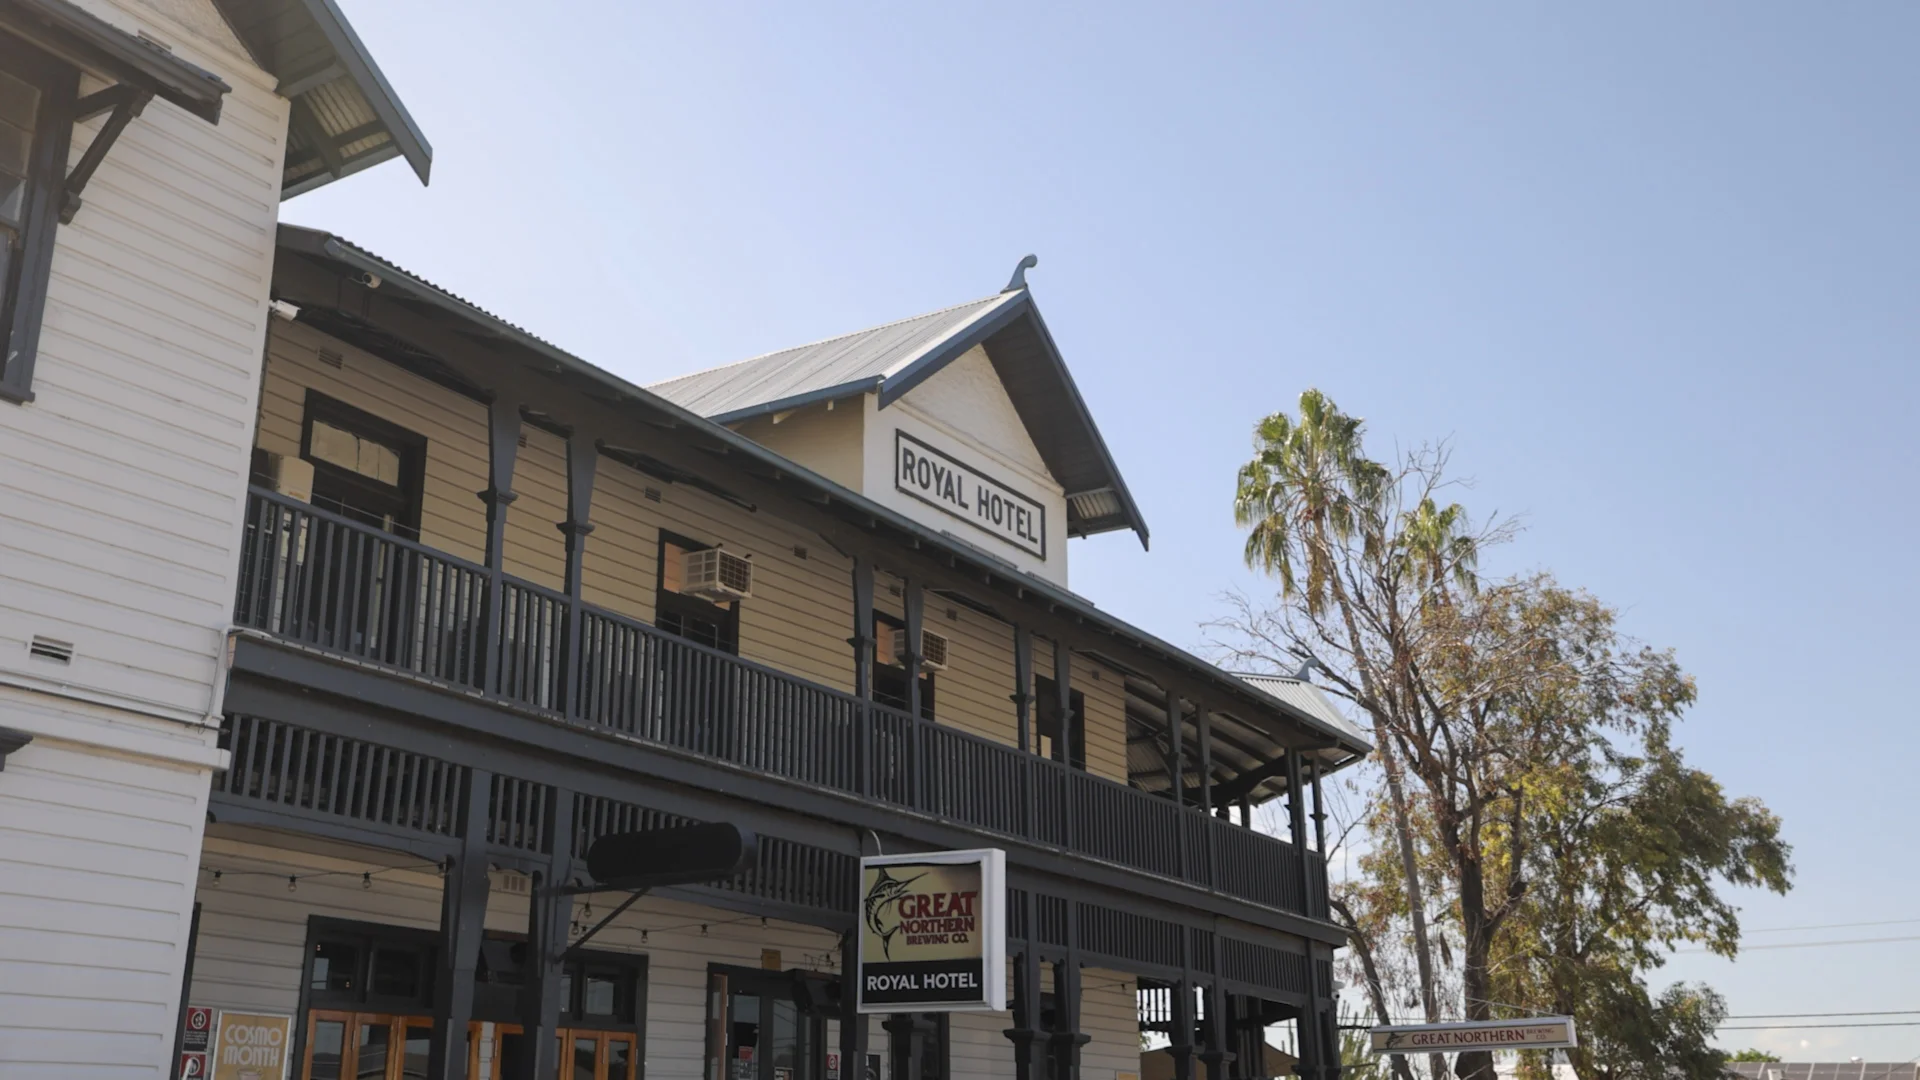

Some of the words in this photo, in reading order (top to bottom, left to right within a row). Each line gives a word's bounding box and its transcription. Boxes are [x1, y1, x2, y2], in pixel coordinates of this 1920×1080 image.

[902, 446, 969, 510] ROYAL
[977, 484, 1038, 544] HOTEL
[898, 891, 978, 919] GREAT
[900, 917, 975, 934] NORTHERN
[906, 933, 949, 945] BREWING
[951, 933, 969, 943] CO.
[867, 974, 919, 991] ROYAL
[923, 972, 978, 989] HOTEL
[224, 1024, 283, 1046] COSMO
[1411, 1032, 1452, 1045] GREAT
[1454, 1029, 1525, 1043] NORTHERN
[223, 1045, 280, 1067] MONTH
